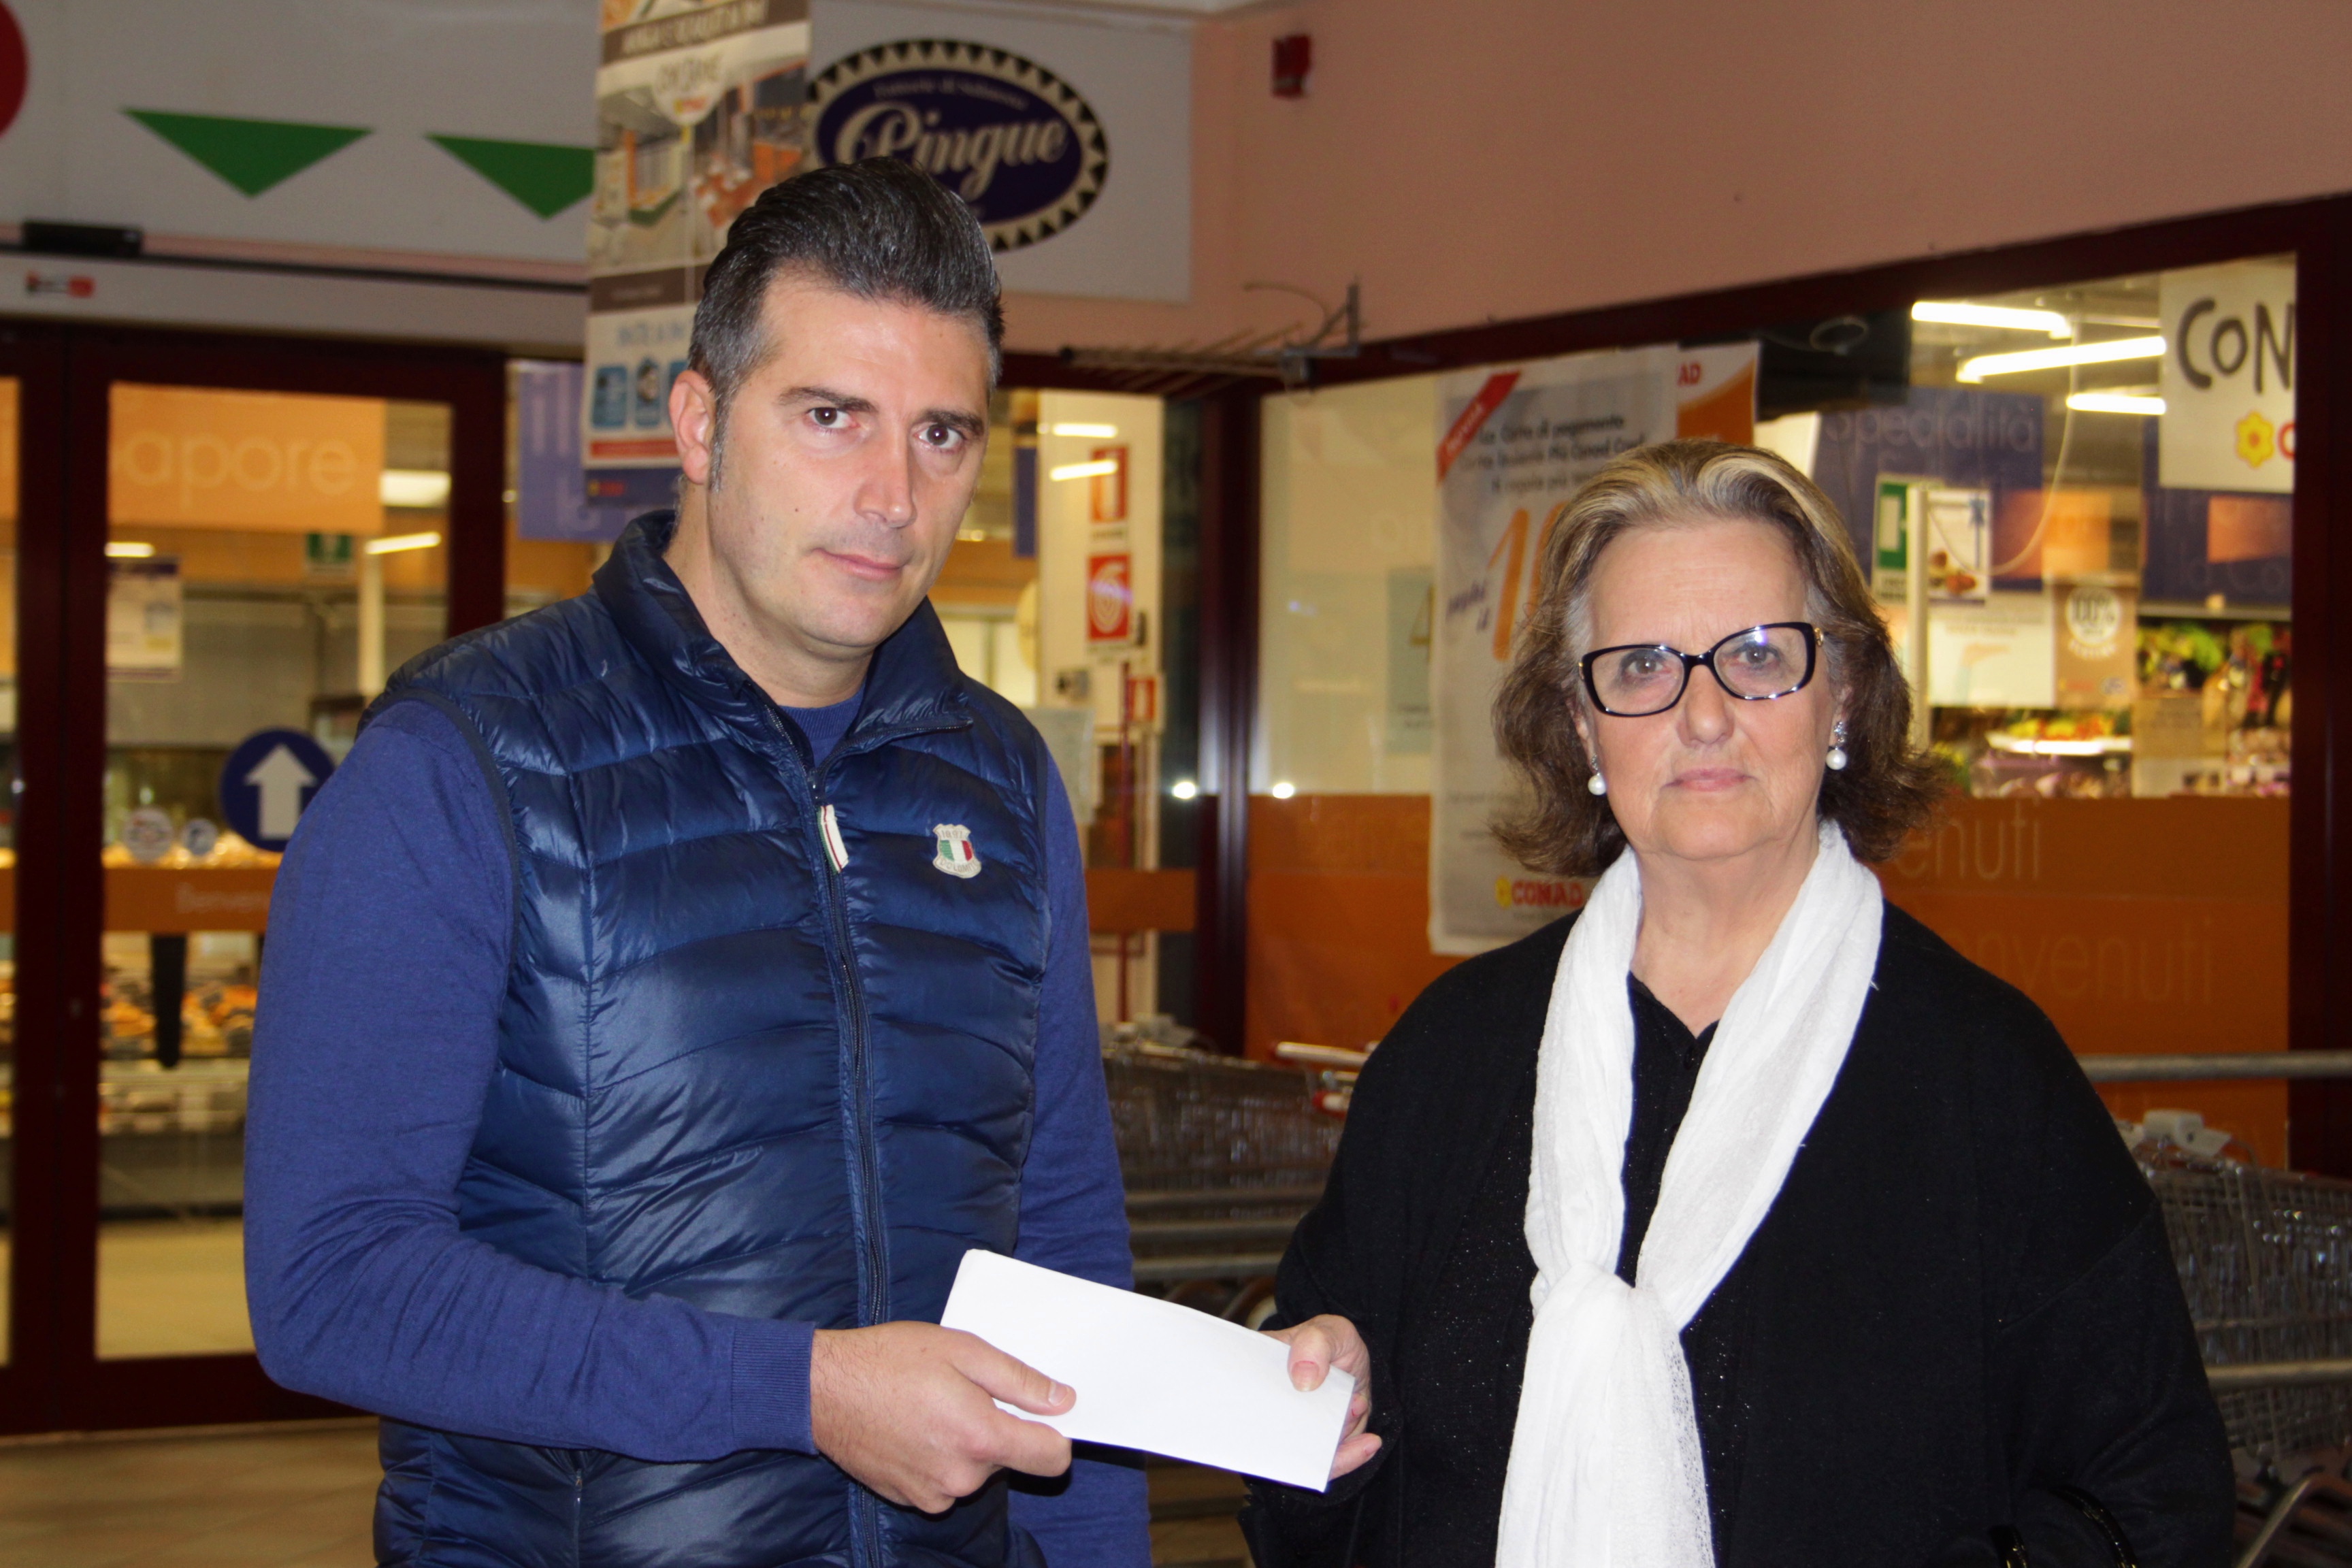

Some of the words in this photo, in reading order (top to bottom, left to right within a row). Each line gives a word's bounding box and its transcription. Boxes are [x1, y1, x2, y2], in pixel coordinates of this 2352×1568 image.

[835, 100, 1067, 203] Pingue
[1677, 363, 1701, 386] AD
[111, 431, 357, 513] apore
[1511, 879, 1584, 909] CONAD
